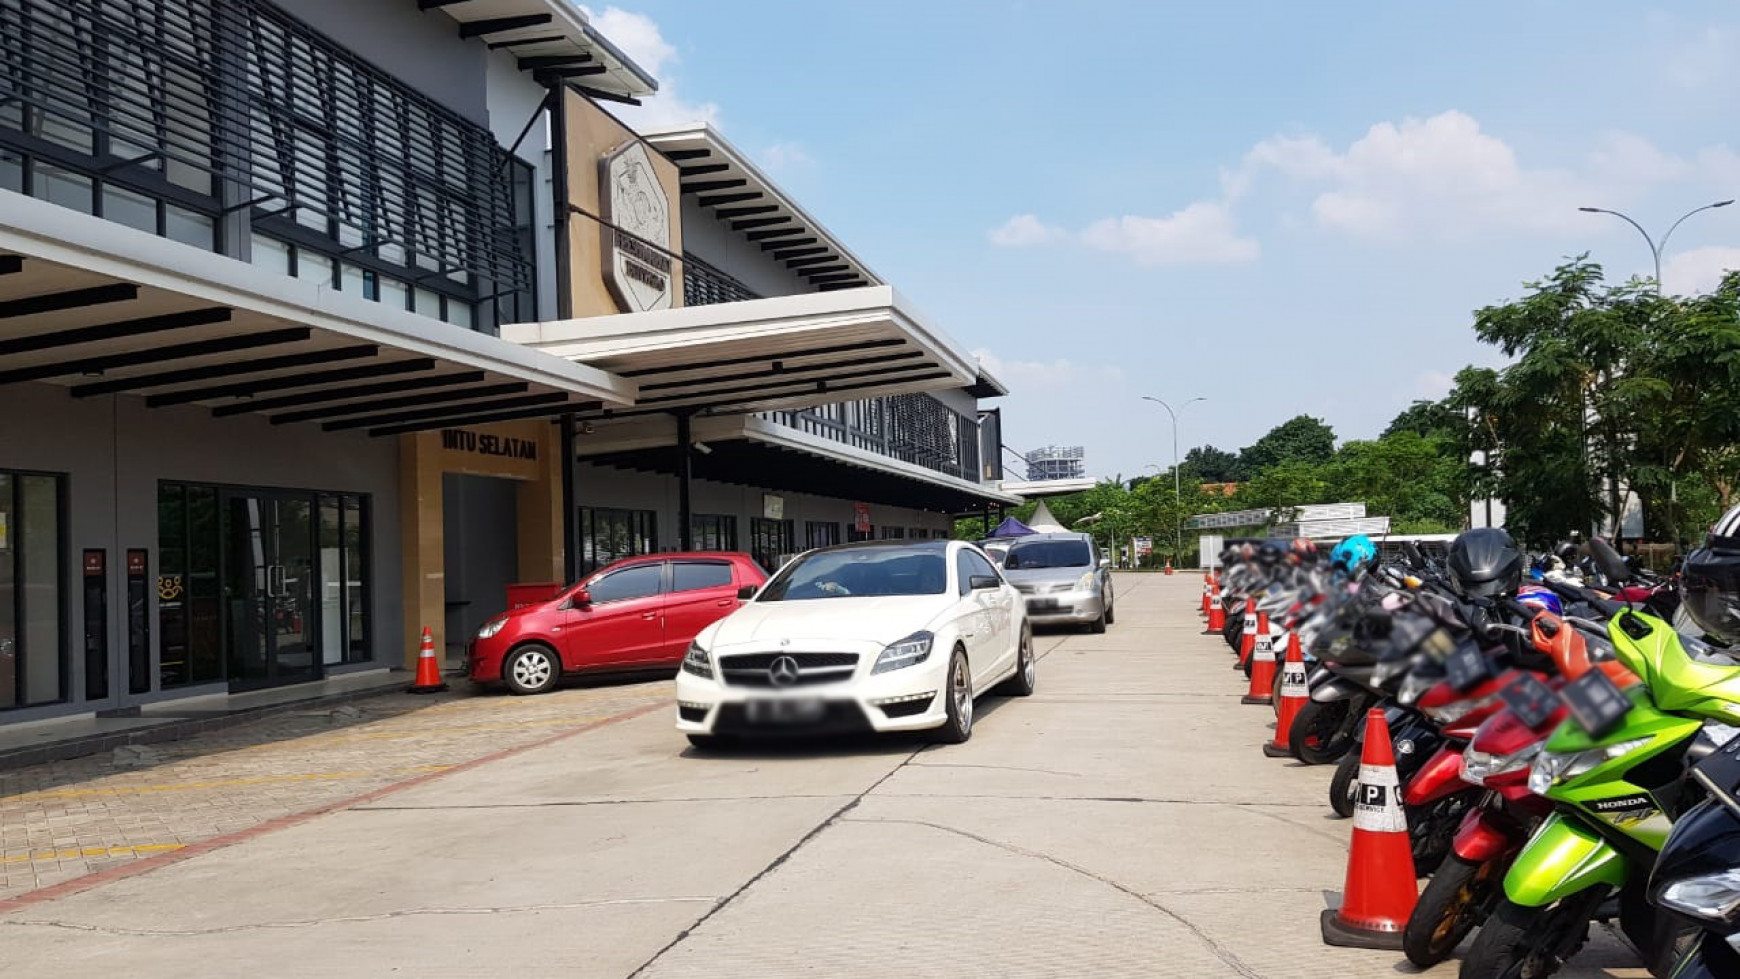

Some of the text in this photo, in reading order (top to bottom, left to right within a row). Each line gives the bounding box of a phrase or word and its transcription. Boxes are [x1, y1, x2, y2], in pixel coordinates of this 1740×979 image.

[442, 429, 537, 460] INTU SELATAN
[1596, 797, 1648, 810] HONDA
